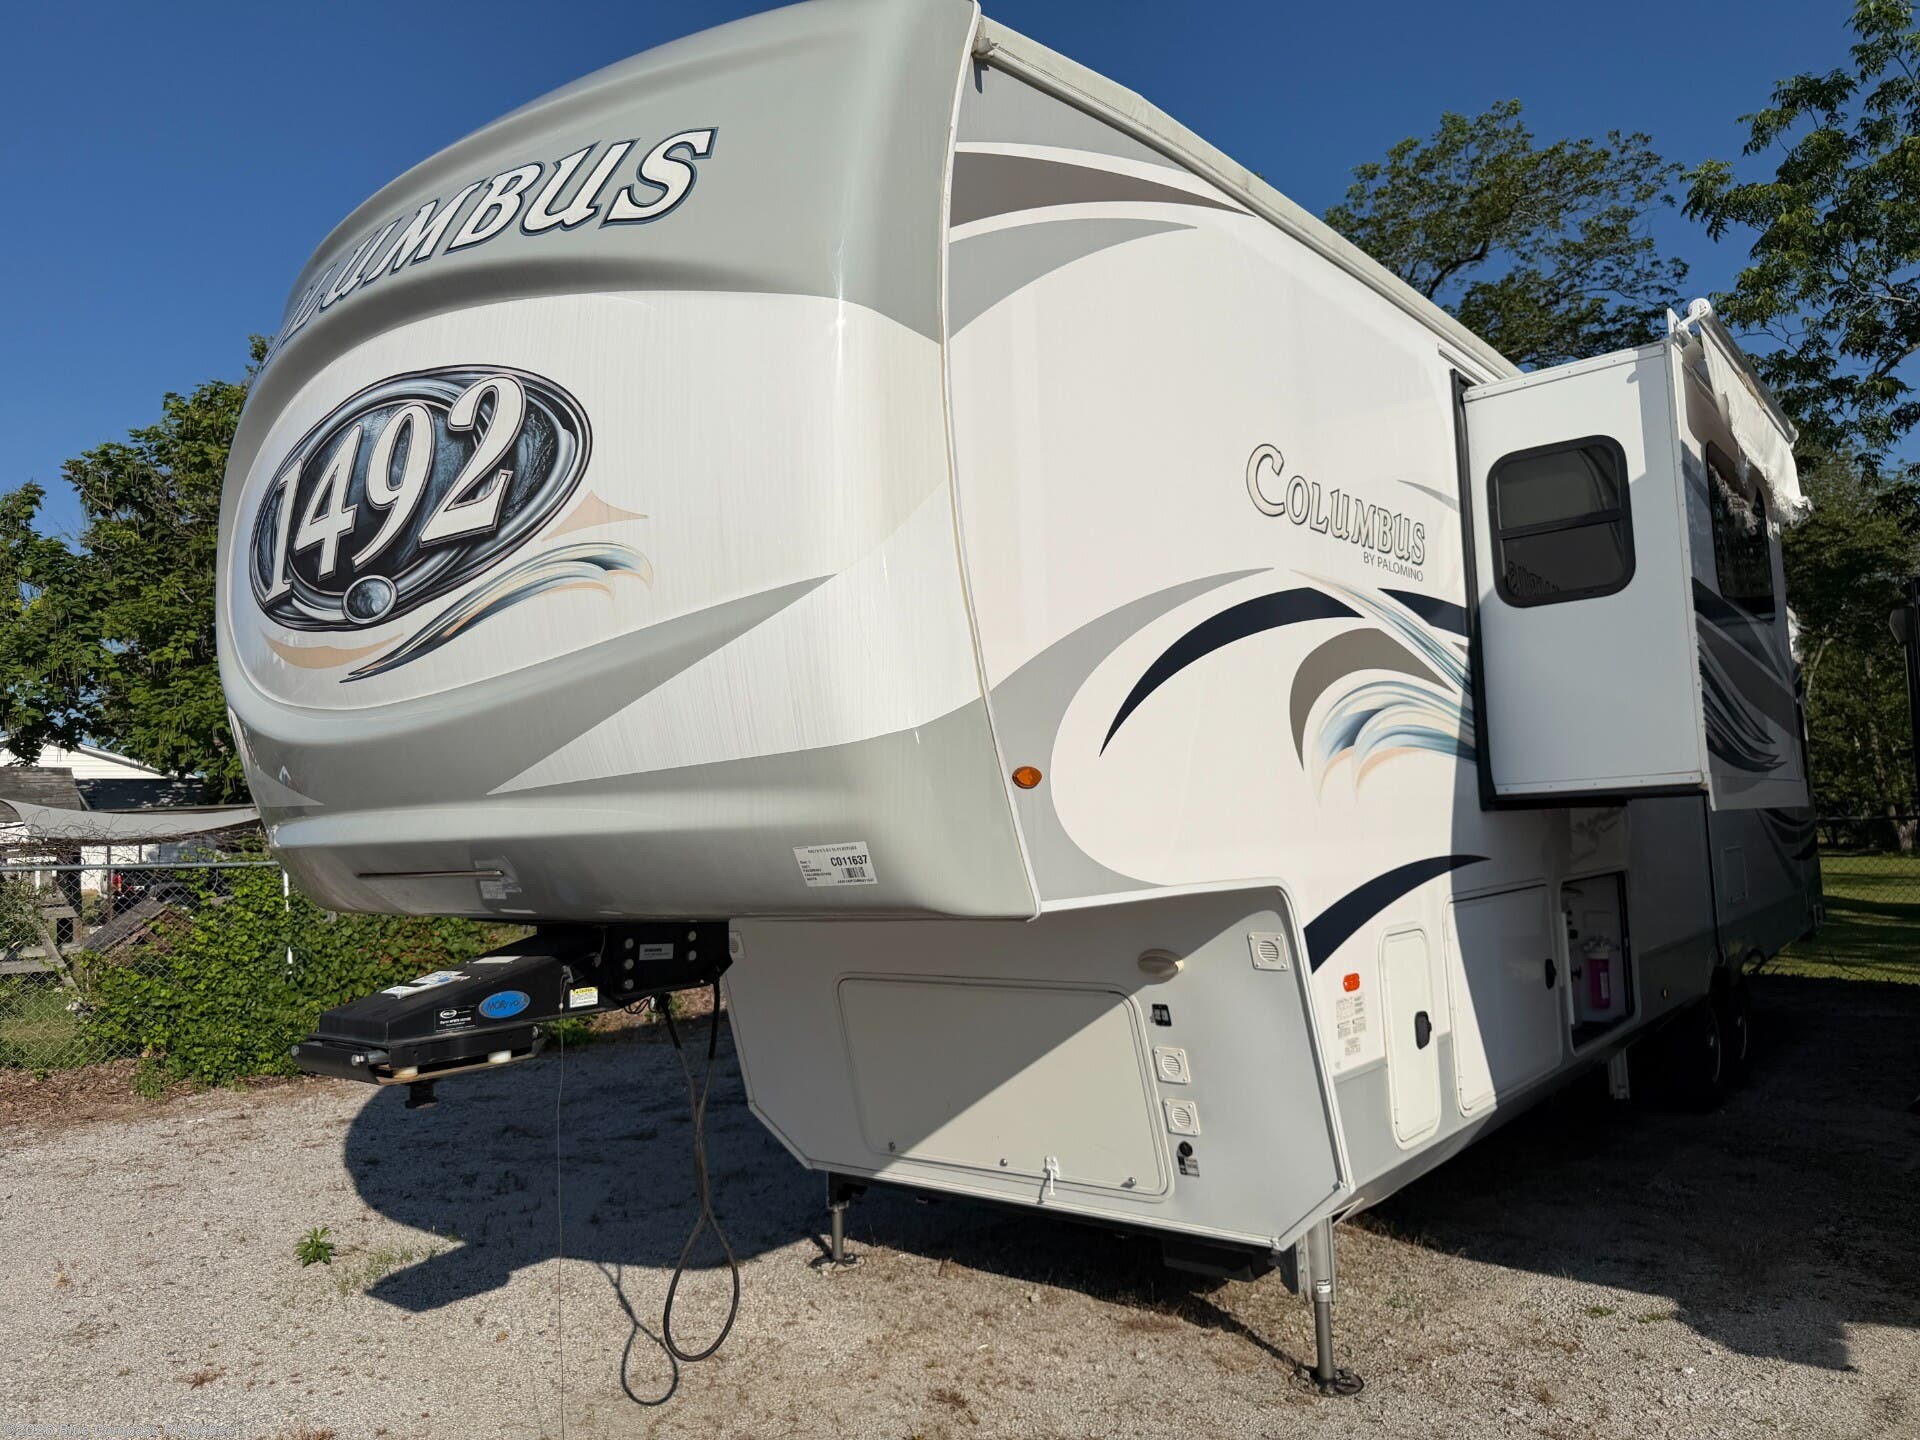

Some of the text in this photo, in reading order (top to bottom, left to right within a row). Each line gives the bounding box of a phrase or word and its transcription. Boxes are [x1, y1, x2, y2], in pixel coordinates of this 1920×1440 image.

[263, 373, 527, 609] 1492
[1363, 551, 1424, 582] BY PALOMINO
[830, 855, 867, 867] C011637
